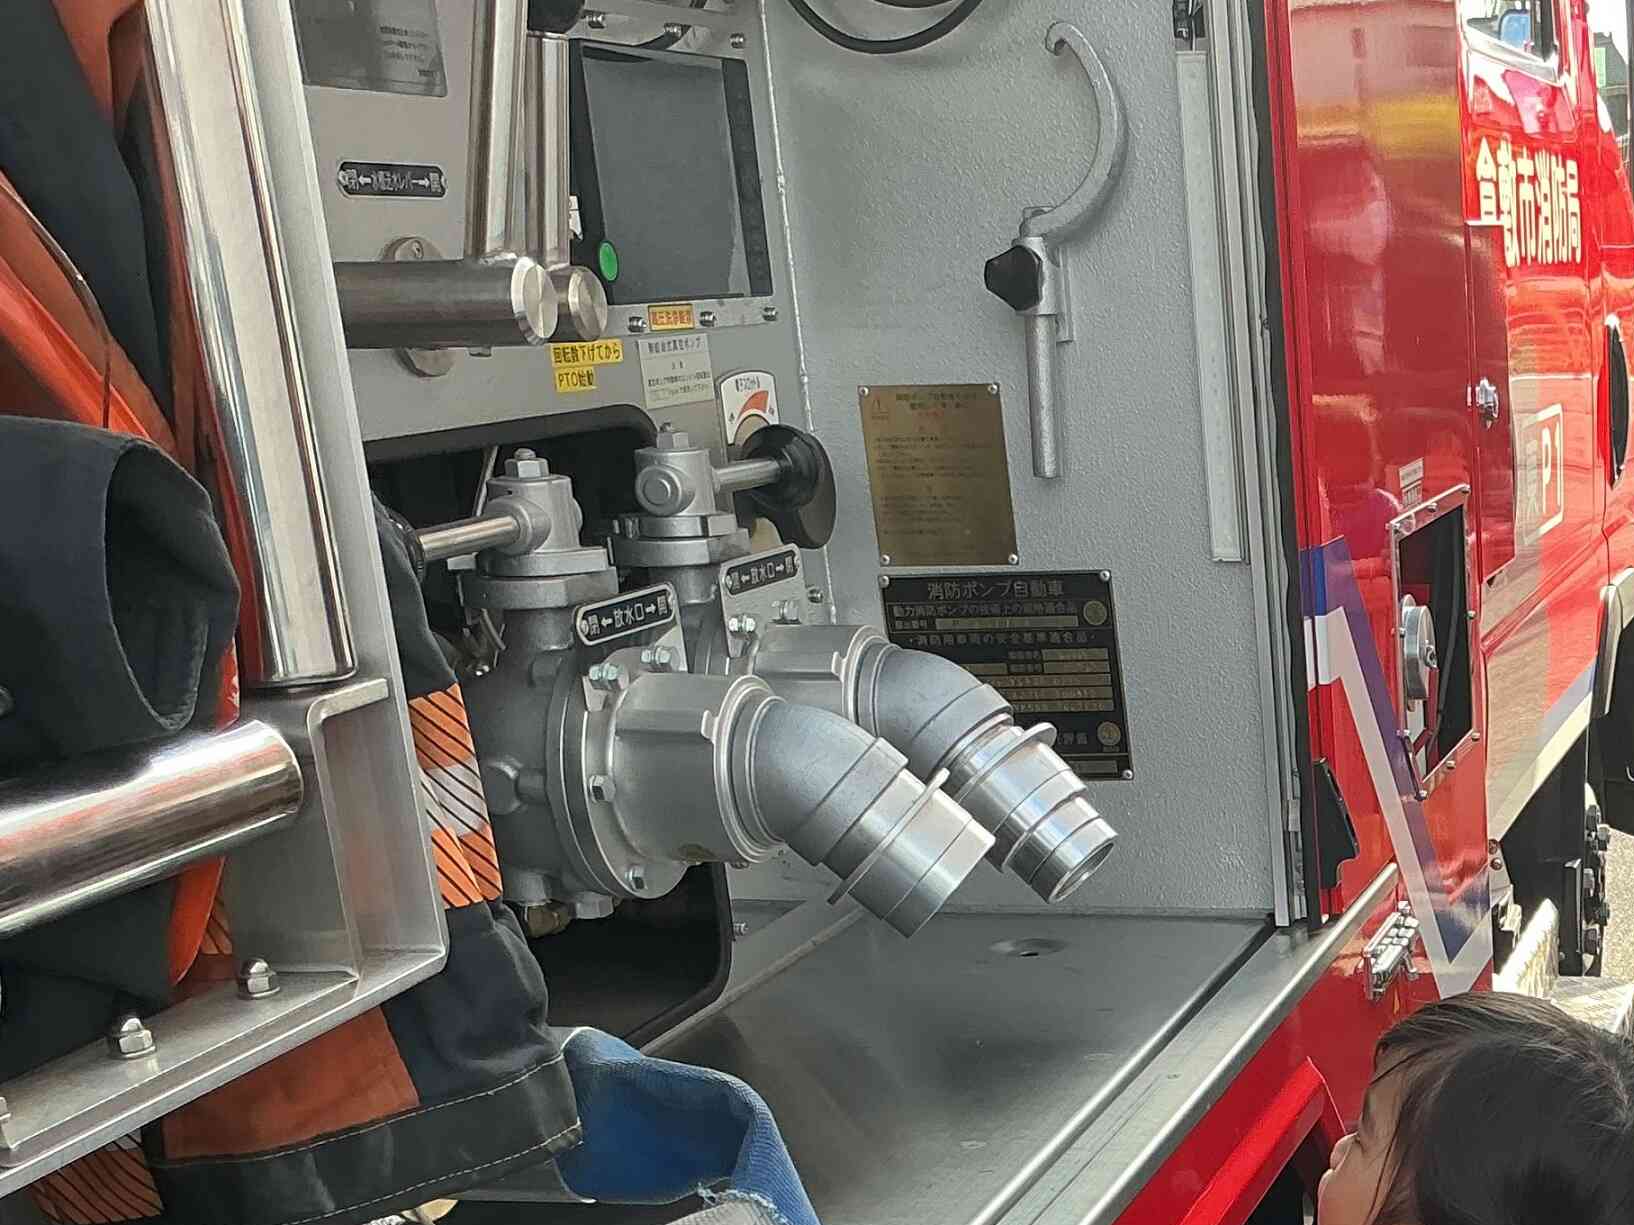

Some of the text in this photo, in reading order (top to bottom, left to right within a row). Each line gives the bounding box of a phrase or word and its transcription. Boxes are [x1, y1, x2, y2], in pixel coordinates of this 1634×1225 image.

[1476, 135, 1582, 267] 倉敷市消防局
[552, 342, 621, 364] 回転数下げてから
[558, 369, 595, 389] PTO始動
[750, 561, 776, 584] 放水口
[927, 579, 1065, 601] 消防ポンプ自動車
[614, 602, 645, 628] 放水口
